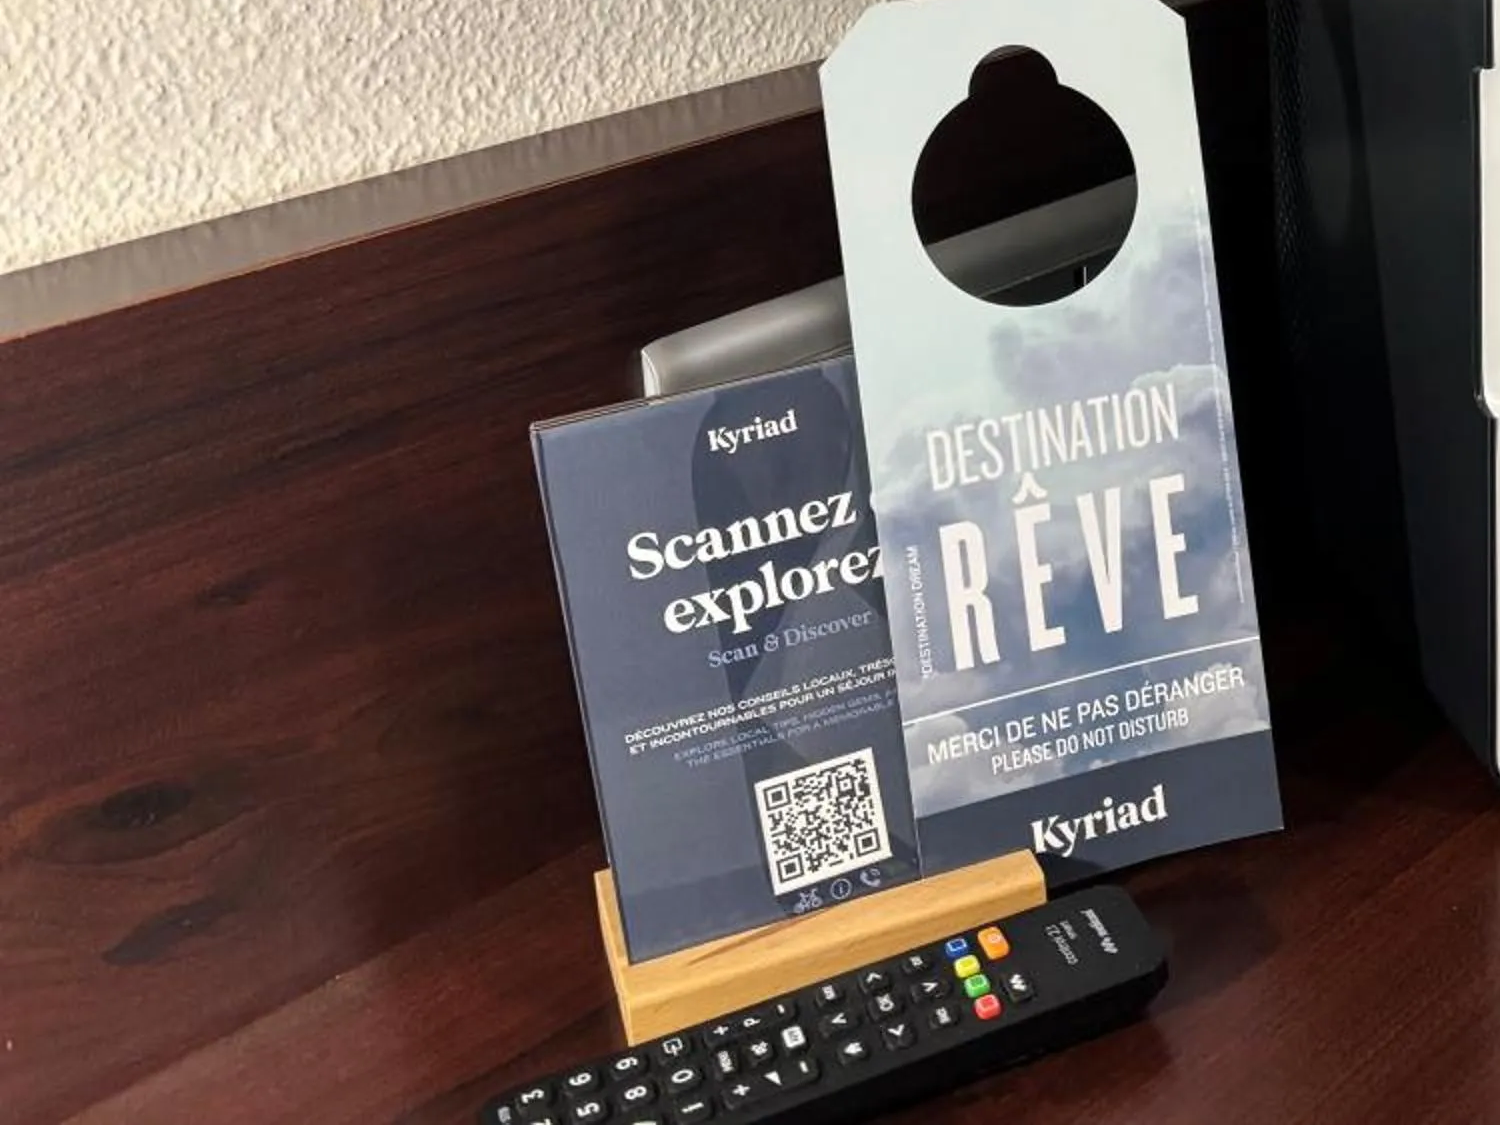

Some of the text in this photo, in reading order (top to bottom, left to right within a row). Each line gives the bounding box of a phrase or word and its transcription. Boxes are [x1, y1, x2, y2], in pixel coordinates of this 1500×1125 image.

[707, 408, 799, 455] Kyriad
[926, 383, 1180, 492] DESTINATION
[627, 490, 857, 581] Scannez
[939, 472, 1199, 672] RÊVE
[707, 610, 872, 668] Scan & Discover
[629, 742, 647, 756] ET
[649, 704, 778, 750] INCONTOURNABLES
[779, 691, 816, 710] POUR
[816, 684, 836, 700] UN
[837, 670, 887, 694] SÉJOUR
[707, 704, 736, 721] NOS
[737, 684, 801, 711] CONSEILS
[926, 665, 1246, 766] MERCI DE NE PAS DÉRANGER
[991, 707, 1190, 776] PLEASE DO NOT DISTURB
[1030, 782, 1169, 859] Kyriad
[568, 1072, 592, 1087] 6
[615, 1056, 639, 1071] 9
[520, 1088, 545, 1104] 3
[576, 1101, 600, 1118] 5
[624, 1085, 648, 1101] 8
